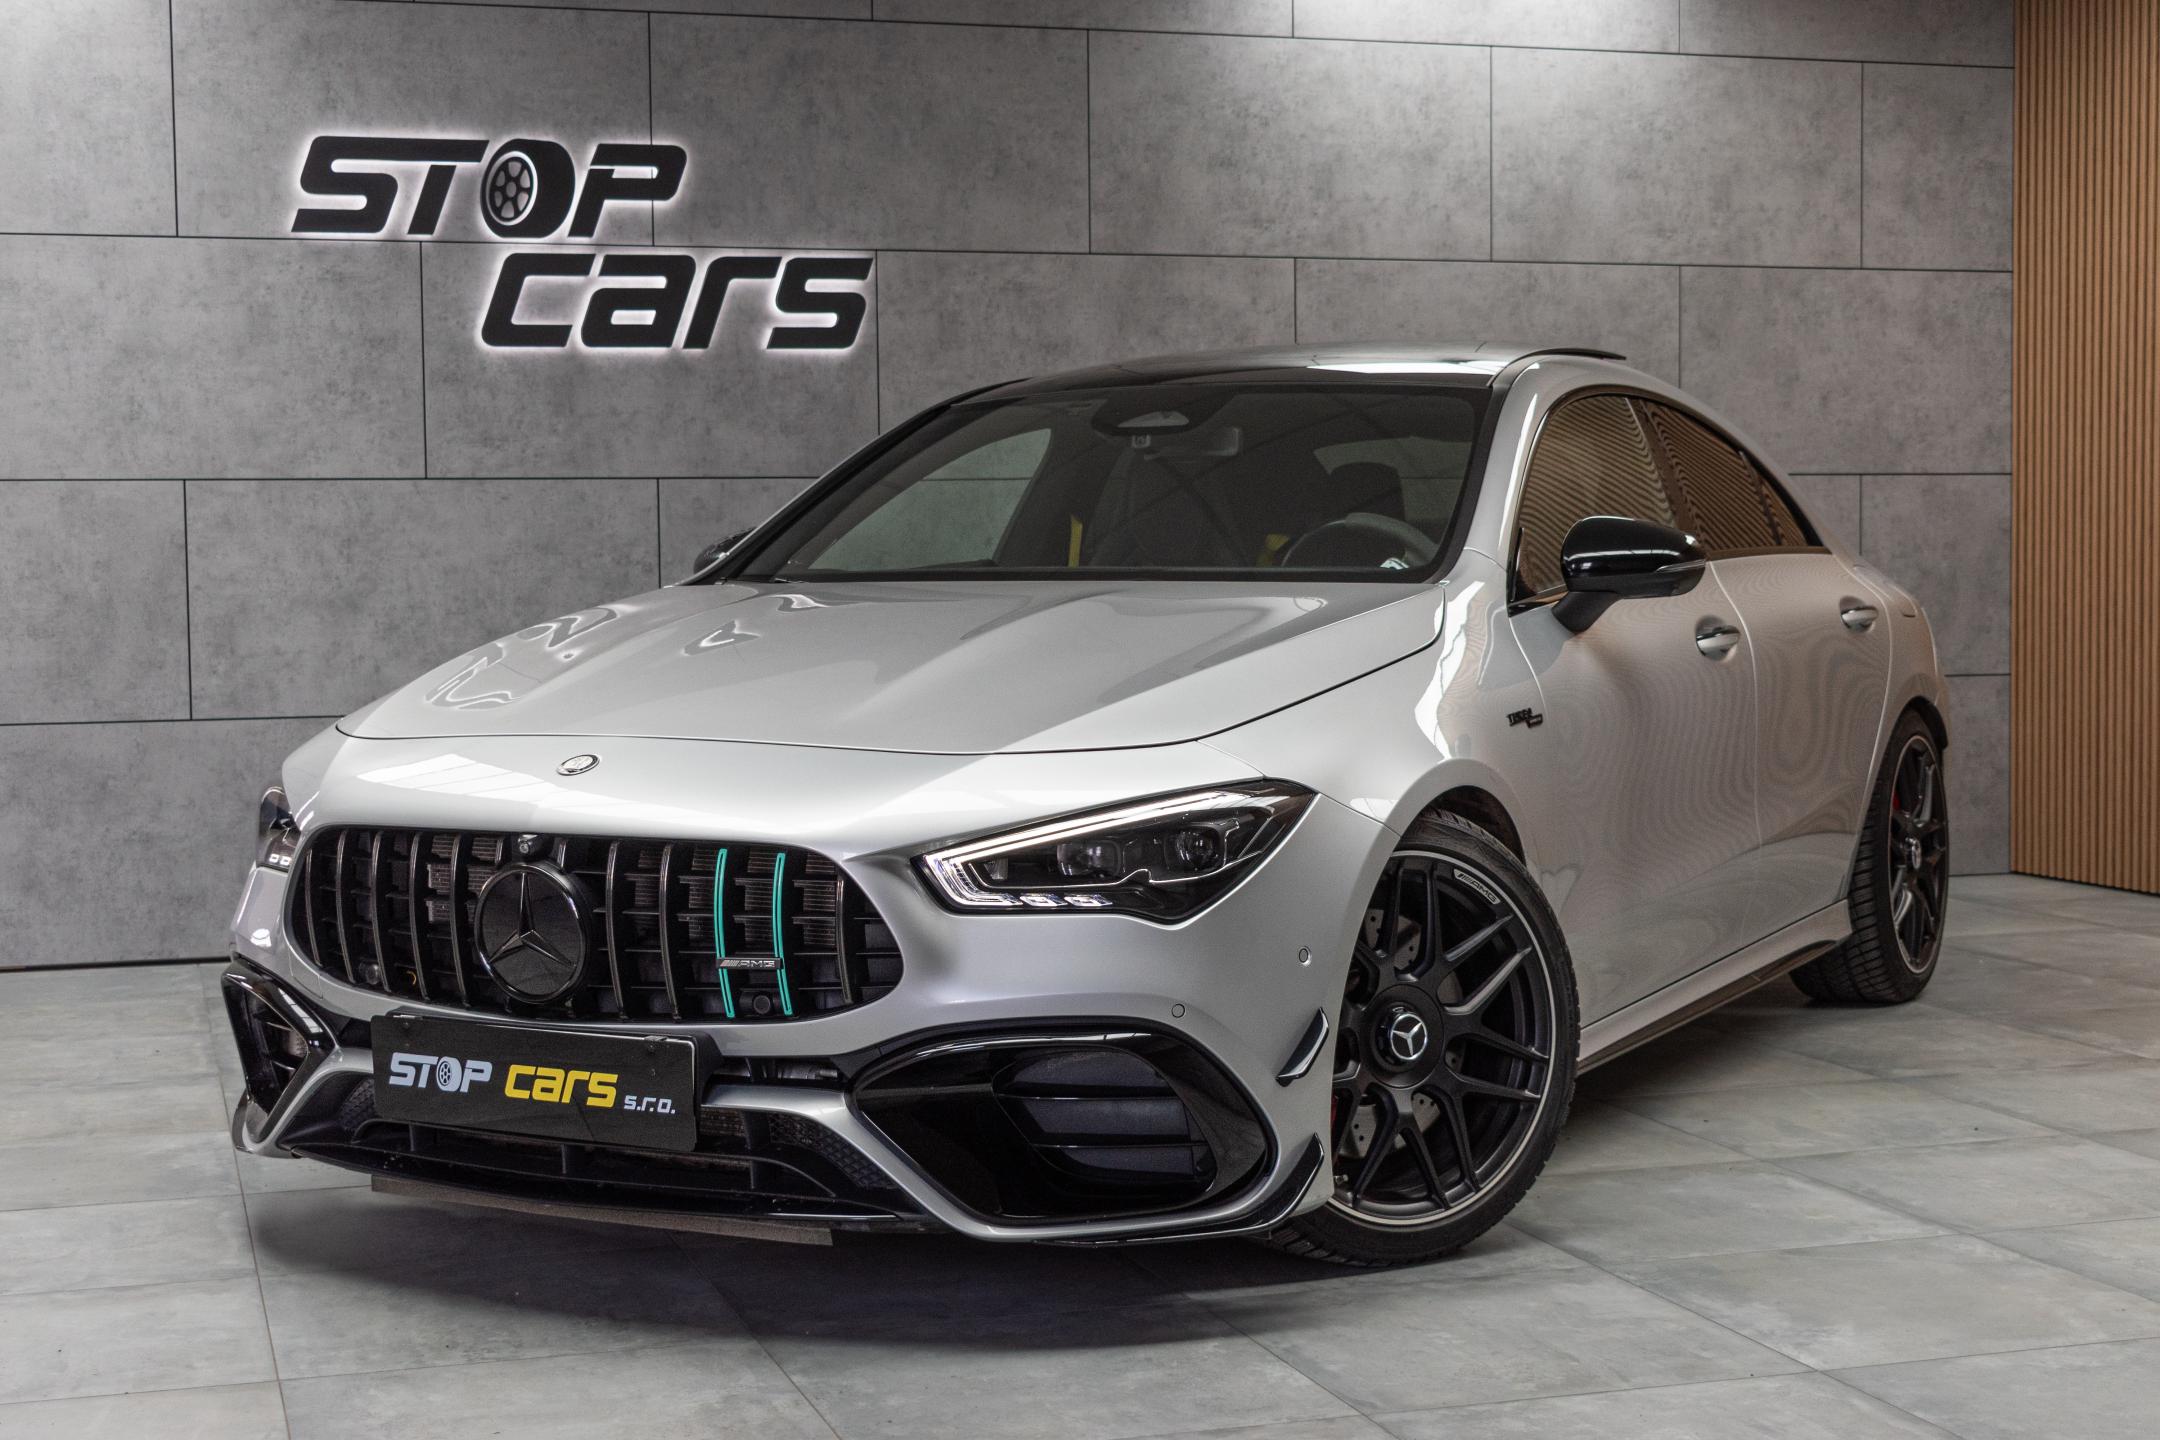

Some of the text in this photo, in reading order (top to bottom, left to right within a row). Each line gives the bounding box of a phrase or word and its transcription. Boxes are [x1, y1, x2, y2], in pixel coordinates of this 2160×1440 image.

[290, 135, 688, 239] STOP
[388, 1051, 493, 1093] STOP
[623, 1094, 676, 1114] s.r.o.
